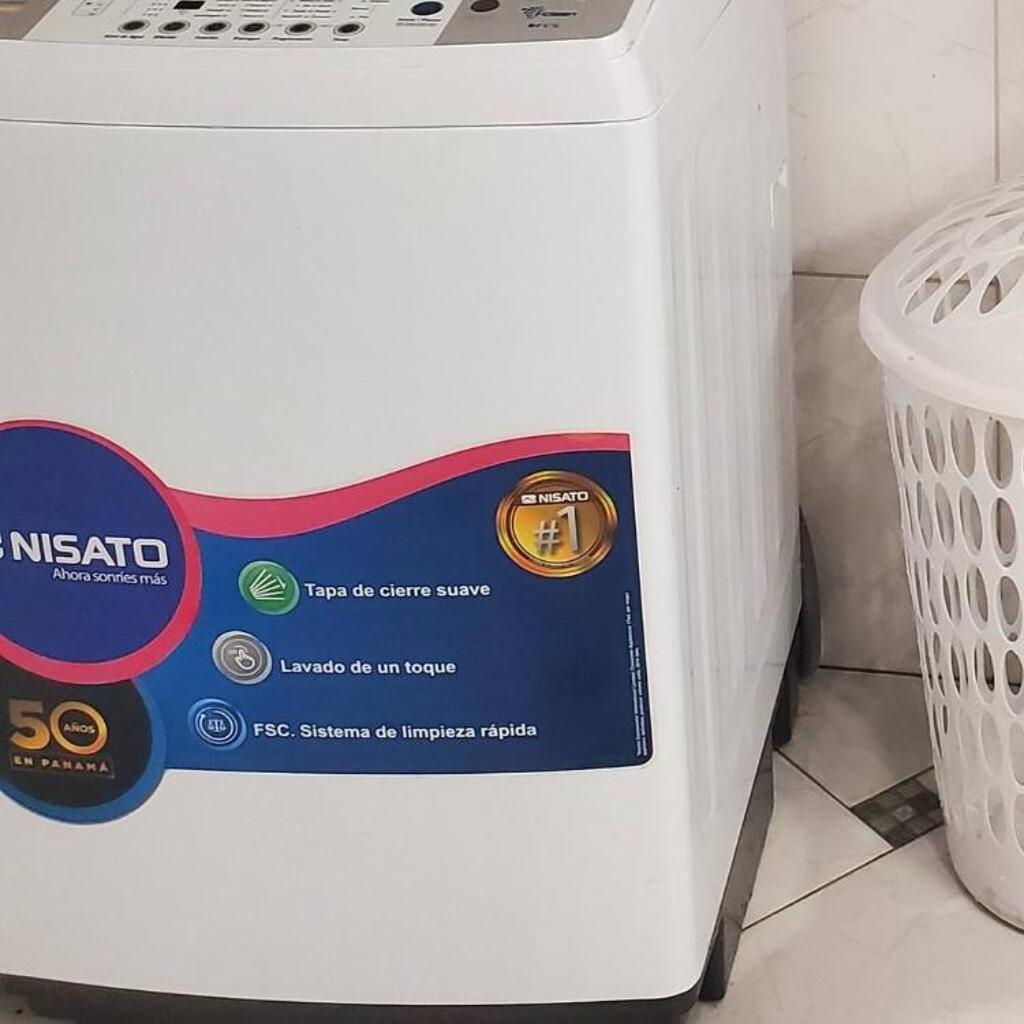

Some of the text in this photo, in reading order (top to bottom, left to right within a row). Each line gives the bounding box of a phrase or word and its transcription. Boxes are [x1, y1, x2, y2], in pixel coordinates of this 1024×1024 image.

[539, 491, 589, 504] NISATO
[534, 505, 579, 555] #1
[10, 531, 168, 569] NISATO
[53, 567, 168, 586] Ahora sonríes más
[304, 582, 491, 599] Tapa de cierre suave
[280, 659, 457, 677] Lavado de un toque
[8, 698, 108, 756] 50
[63, 721, 96, 734] AÑOS
[253, 723, 538, 741] FSC. Sistema de limpieza rápida
[13, 756, 109, 772] EN PANAMÁ
